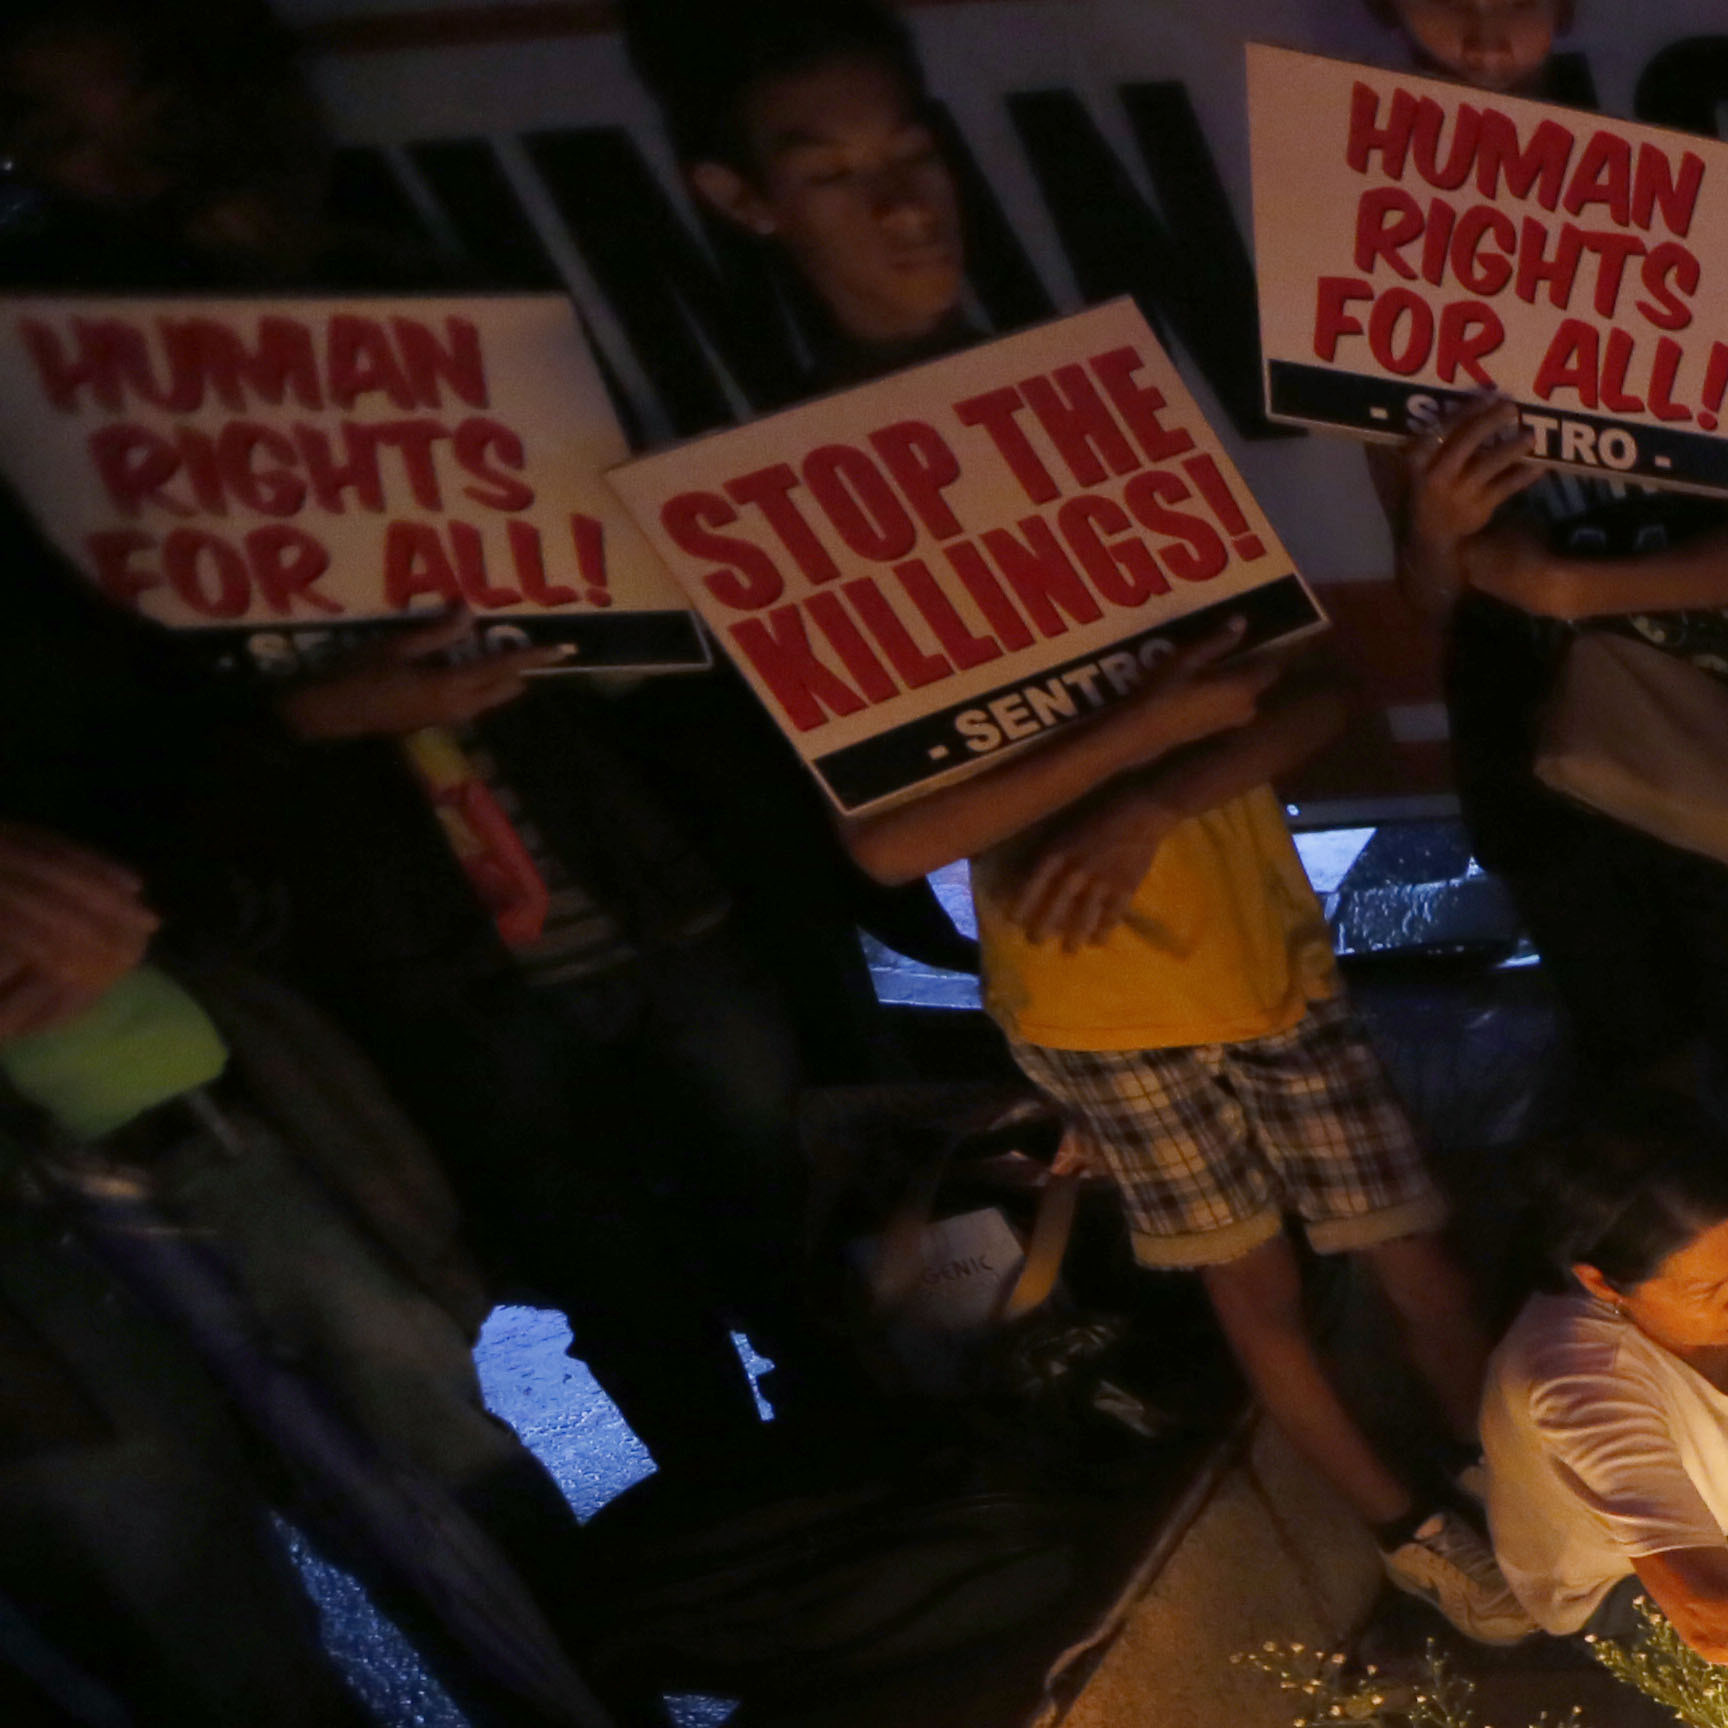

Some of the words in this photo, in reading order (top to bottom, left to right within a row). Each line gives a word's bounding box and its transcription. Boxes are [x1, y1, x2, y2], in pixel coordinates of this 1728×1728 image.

[1346, 79, 1706, 239] HUMAN
[1353, 185, 1701, 332] RIGHTS
[18, 313, 490, 414] HUMAN
[1312, 275, 1506, 391] FOR
[87, 416, 535, 518] RIGHTS
[660, 420, 962, 611] STOP
[954, 345, 1197, 506] THE
[1405, 393, 1639, 470] STRO
[84, 523, 346, 619] FOR
[383, 512, 612, 610] ALL!
[726, 453, 1267, 733] KILLINGS!
